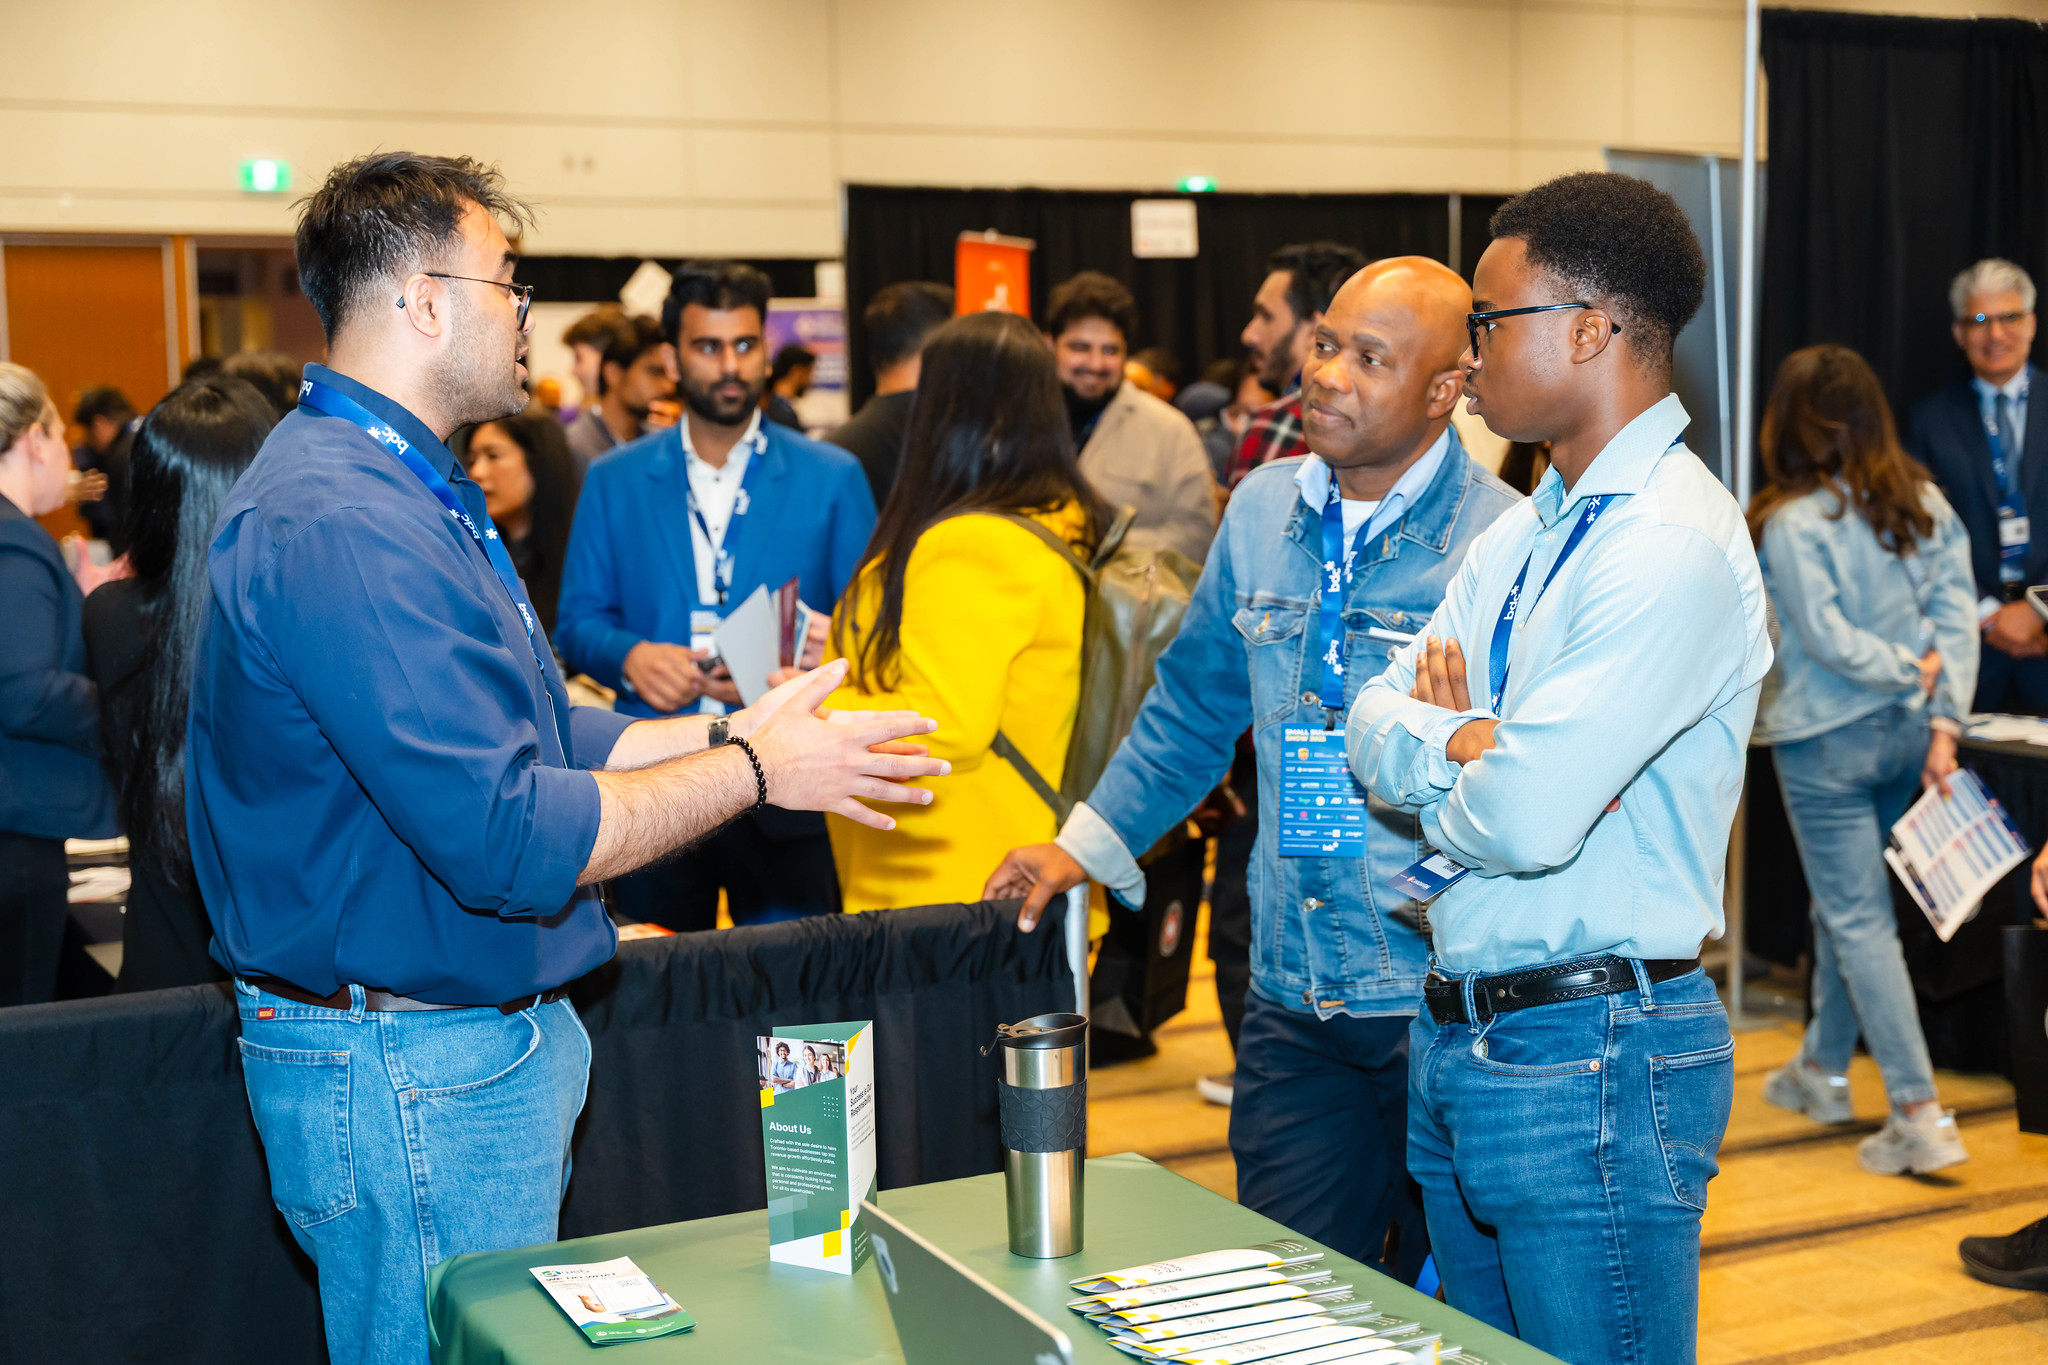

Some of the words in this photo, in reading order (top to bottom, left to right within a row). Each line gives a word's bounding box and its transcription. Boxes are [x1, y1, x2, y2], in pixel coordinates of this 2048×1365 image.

[298, 380, 313, 396] bd
[381, 427, 409, 455] bdc
[1588, 496, 1601, 511] dc
[461, 514, 480, 539] bdc
[1328, 567, 1341, 592] bdc
[1504, 594, 1521, 620] bdc
[1328, 640, 1339, 665] bdc
[769, 1122, 797, 1133] About
[800, 1125, 812, 1134] Us
